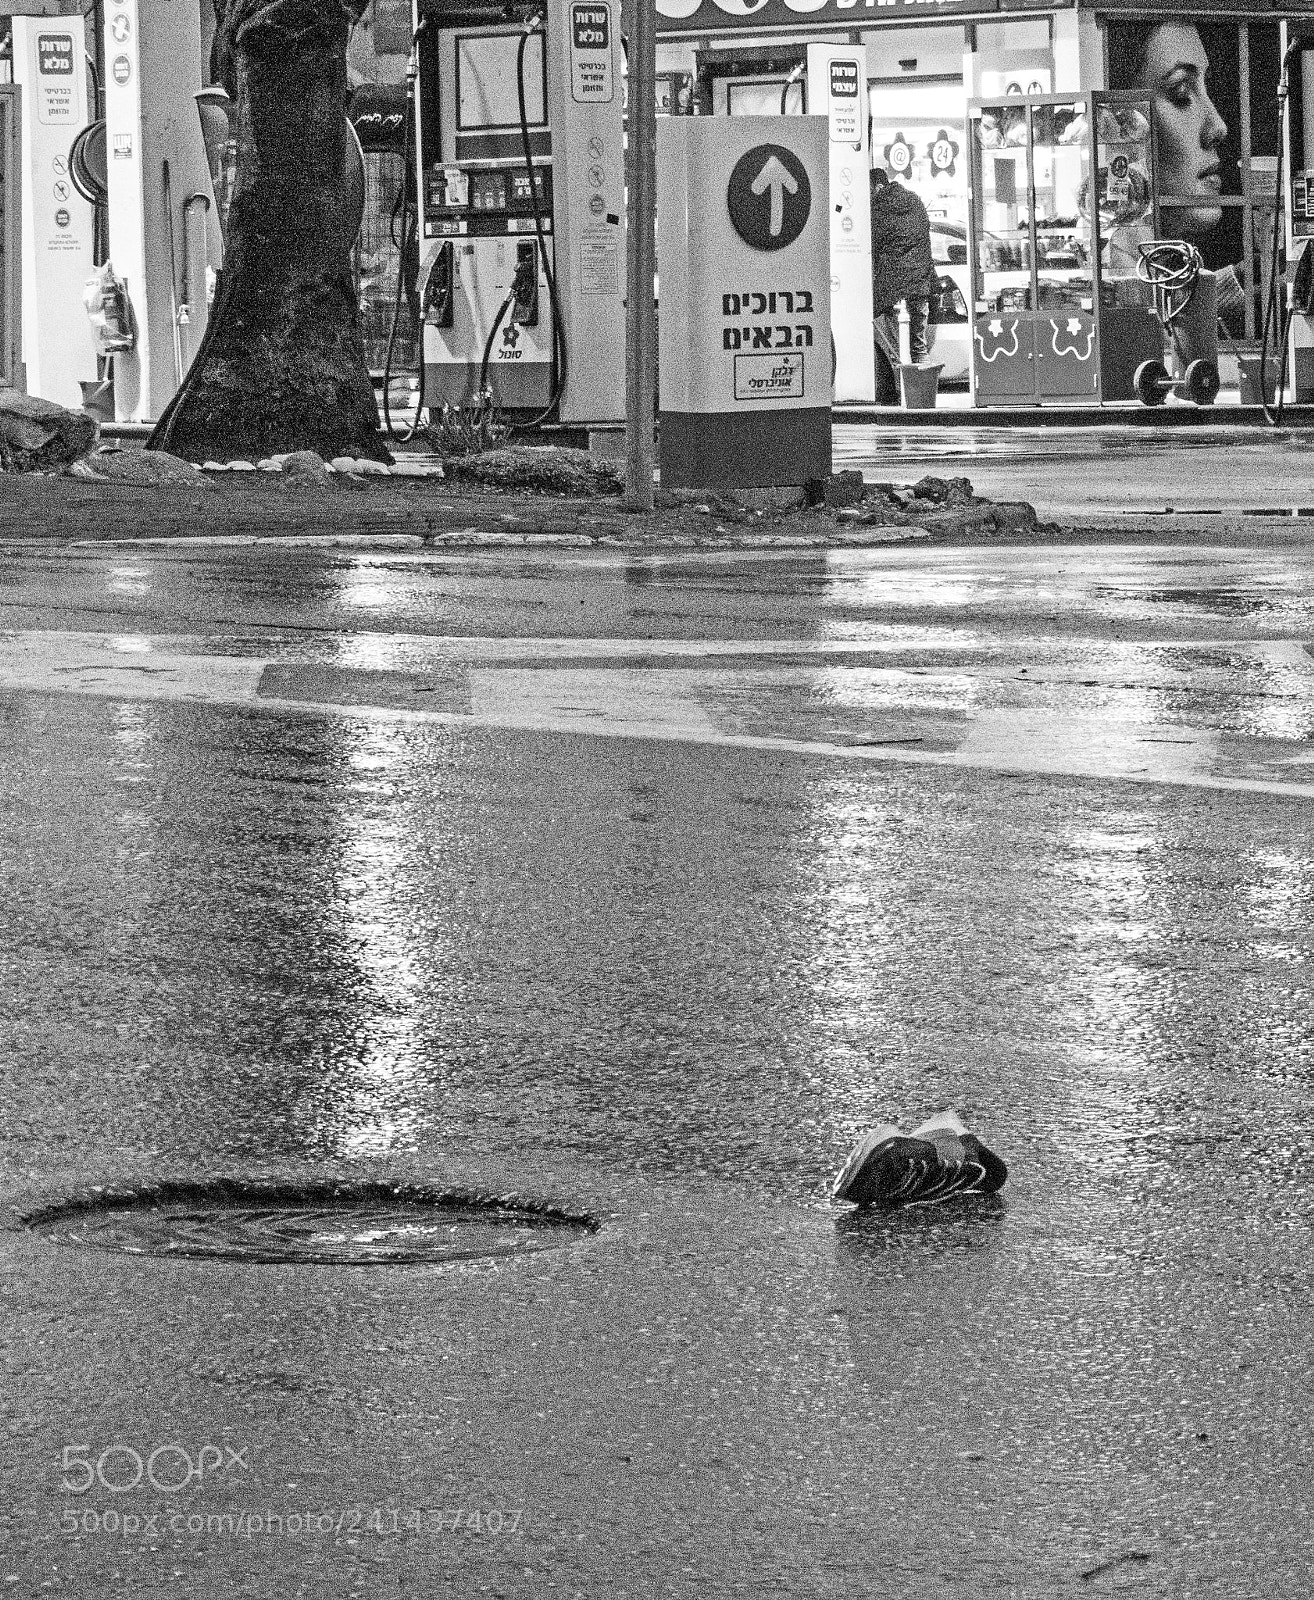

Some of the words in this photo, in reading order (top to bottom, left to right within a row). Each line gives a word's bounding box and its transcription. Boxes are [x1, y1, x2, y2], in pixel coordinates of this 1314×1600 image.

[575, 12, 606, 24] שרות
[578, 29, 604, 43] מלא
[40, 40, 71, 52] שרות
[44, 56, 70, 69] מלא
[831, 66, 857, 77] שרות
[832, 82, 857, 93] עצמי
[937, 145, 949, 164] 24
[722, 290, 814, 316] ברוכים
[722, 324, 814, 350] הבאים
[498, 348, 523, 360] סונול
[748, 377, 793, 389] אוניברסלי
